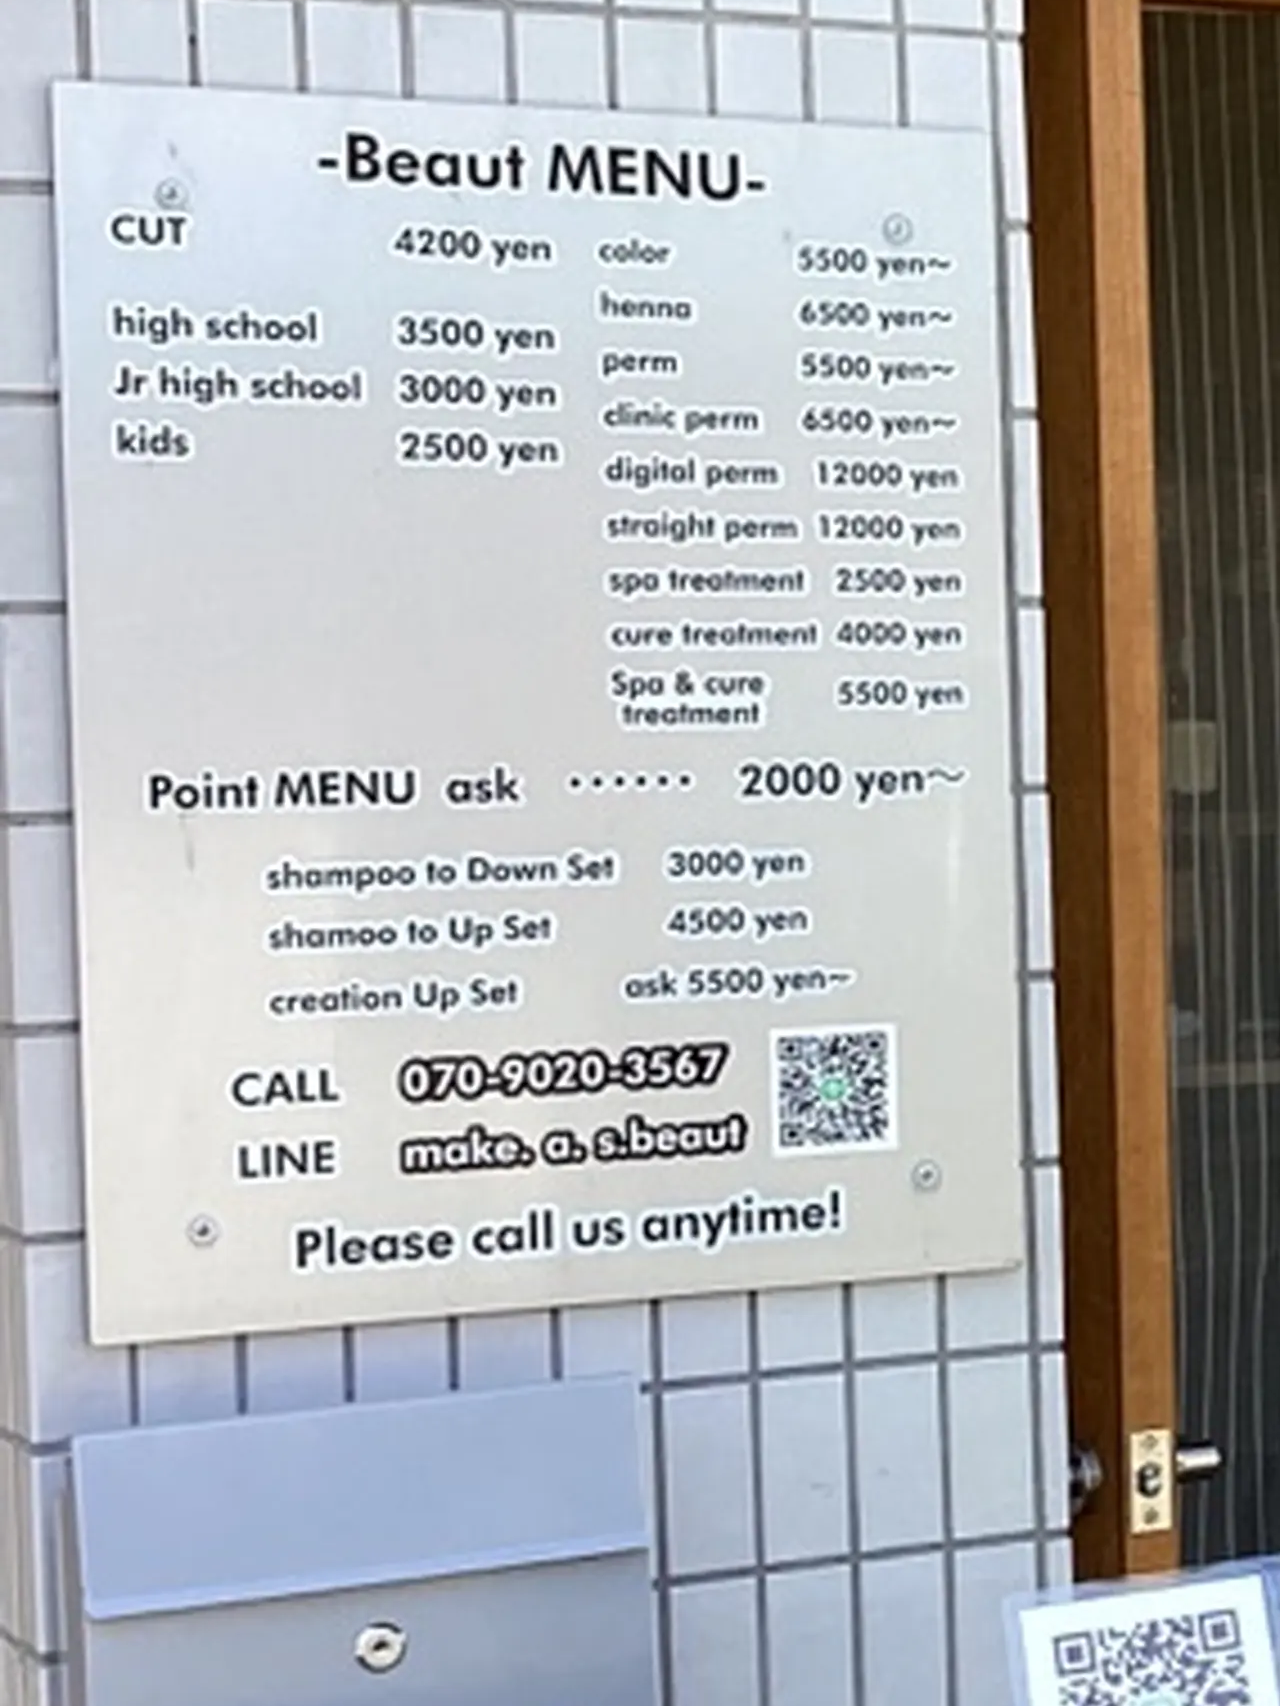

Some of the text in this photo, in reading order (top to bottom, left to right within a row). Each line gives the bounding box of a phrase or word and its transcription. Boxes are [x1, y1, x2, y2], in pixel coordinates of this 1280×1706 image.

[111, 215, 552, 265] CUT 4200 yen
[599, 239, 670, 265] color
[799, 249, 867, 275] 5500
[113, 308, 555, 353] high school 3500 yen
[601, 295, 692, 321] henna
[801, 303, 868, 328] 6500
[603, 350, 678, 378] perm
[802, 355, 870, 380] 5500
[113, 366, 556, 410] Jr high school 3000 yen
[603, 404, 674, 432] clinic
[686, 407, 758, 434] perm
[803, 407, 872, 434] 6500
[116, 425, 558, 466] kids 2500 yen
[606, 458, 958, 492] digital perm 12000 yen
[607, 513, 961, 546] straight perm 12000 yen
[609, 568, 963, 598] spa treatment 2500 yen
[611, 621, 963, 650] cure treatment 4000 yen
[612, 670, 964, 709] Spa & cure 5500 yen
[622, 700, 760, 727] treatment
[149, 773, 260, 811] Point
[274, 770, 417, 807] MENU
[445, 770, 519, 802] ask
[739, 764, 840, 797] 2000
[267, 850, 806, 891] shampoo to Down Set 3000 yen
[269, 908, 807, 952] shamoo to Up Set 4500 yen
[270, 981, 402, 1014] creation
[412, 979, 461, 1014] Up
[470, 979, 518, 1008] Set
[625, 971, 679, 999] ask
[688, 967, 765, 995] 5500
[232, 1047, 728, 1107] CALL 070-9020-3567
[238, 1143, 337, 1177] LINE
[296, 1191, 843, 1268] Please call us anytime!
